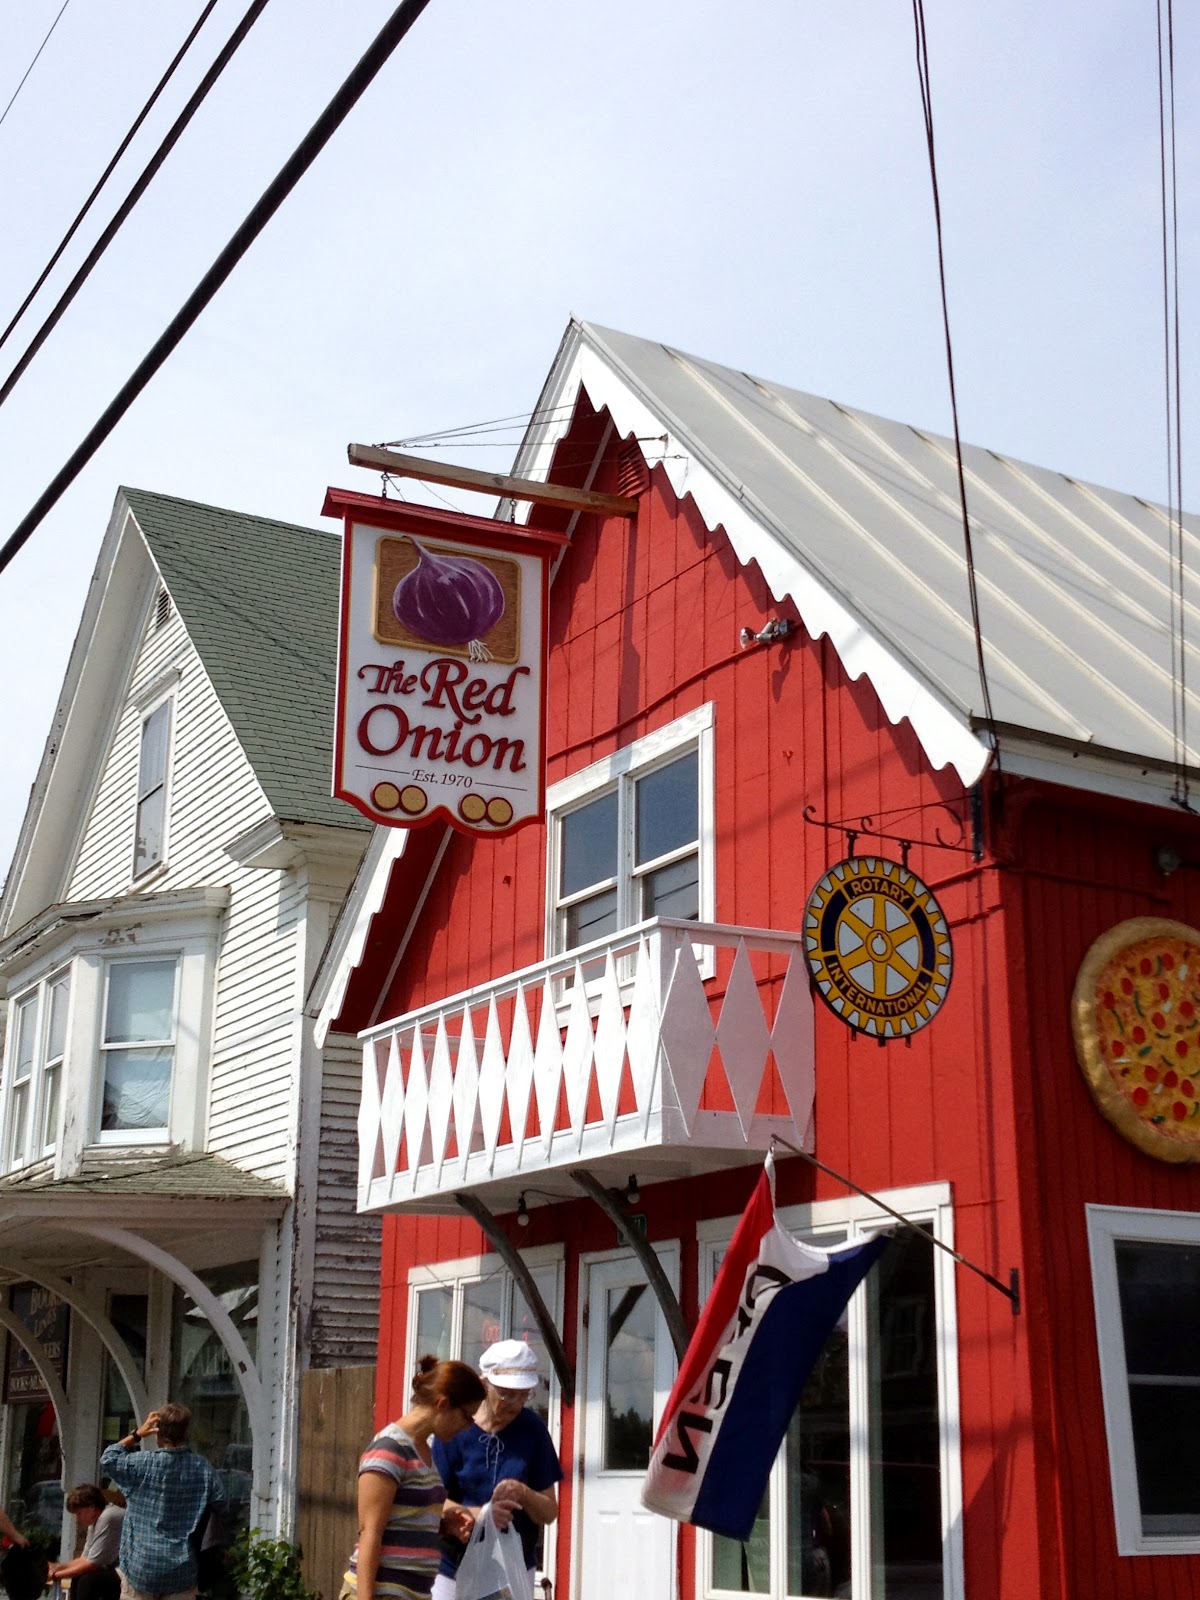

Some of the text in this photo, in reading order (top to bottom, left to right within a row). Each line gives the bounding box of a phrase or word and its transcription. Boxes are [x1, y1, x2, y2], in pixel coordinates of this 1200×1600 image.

[357, 657, 530, 725] The Red
[357, 703, 527, 773] Onion
[412, 769, 473, 788] Est. 1970
[851, 878, 910, 903] ROTARY
[828, 962, 929, 1015] INTERNATIONAL
